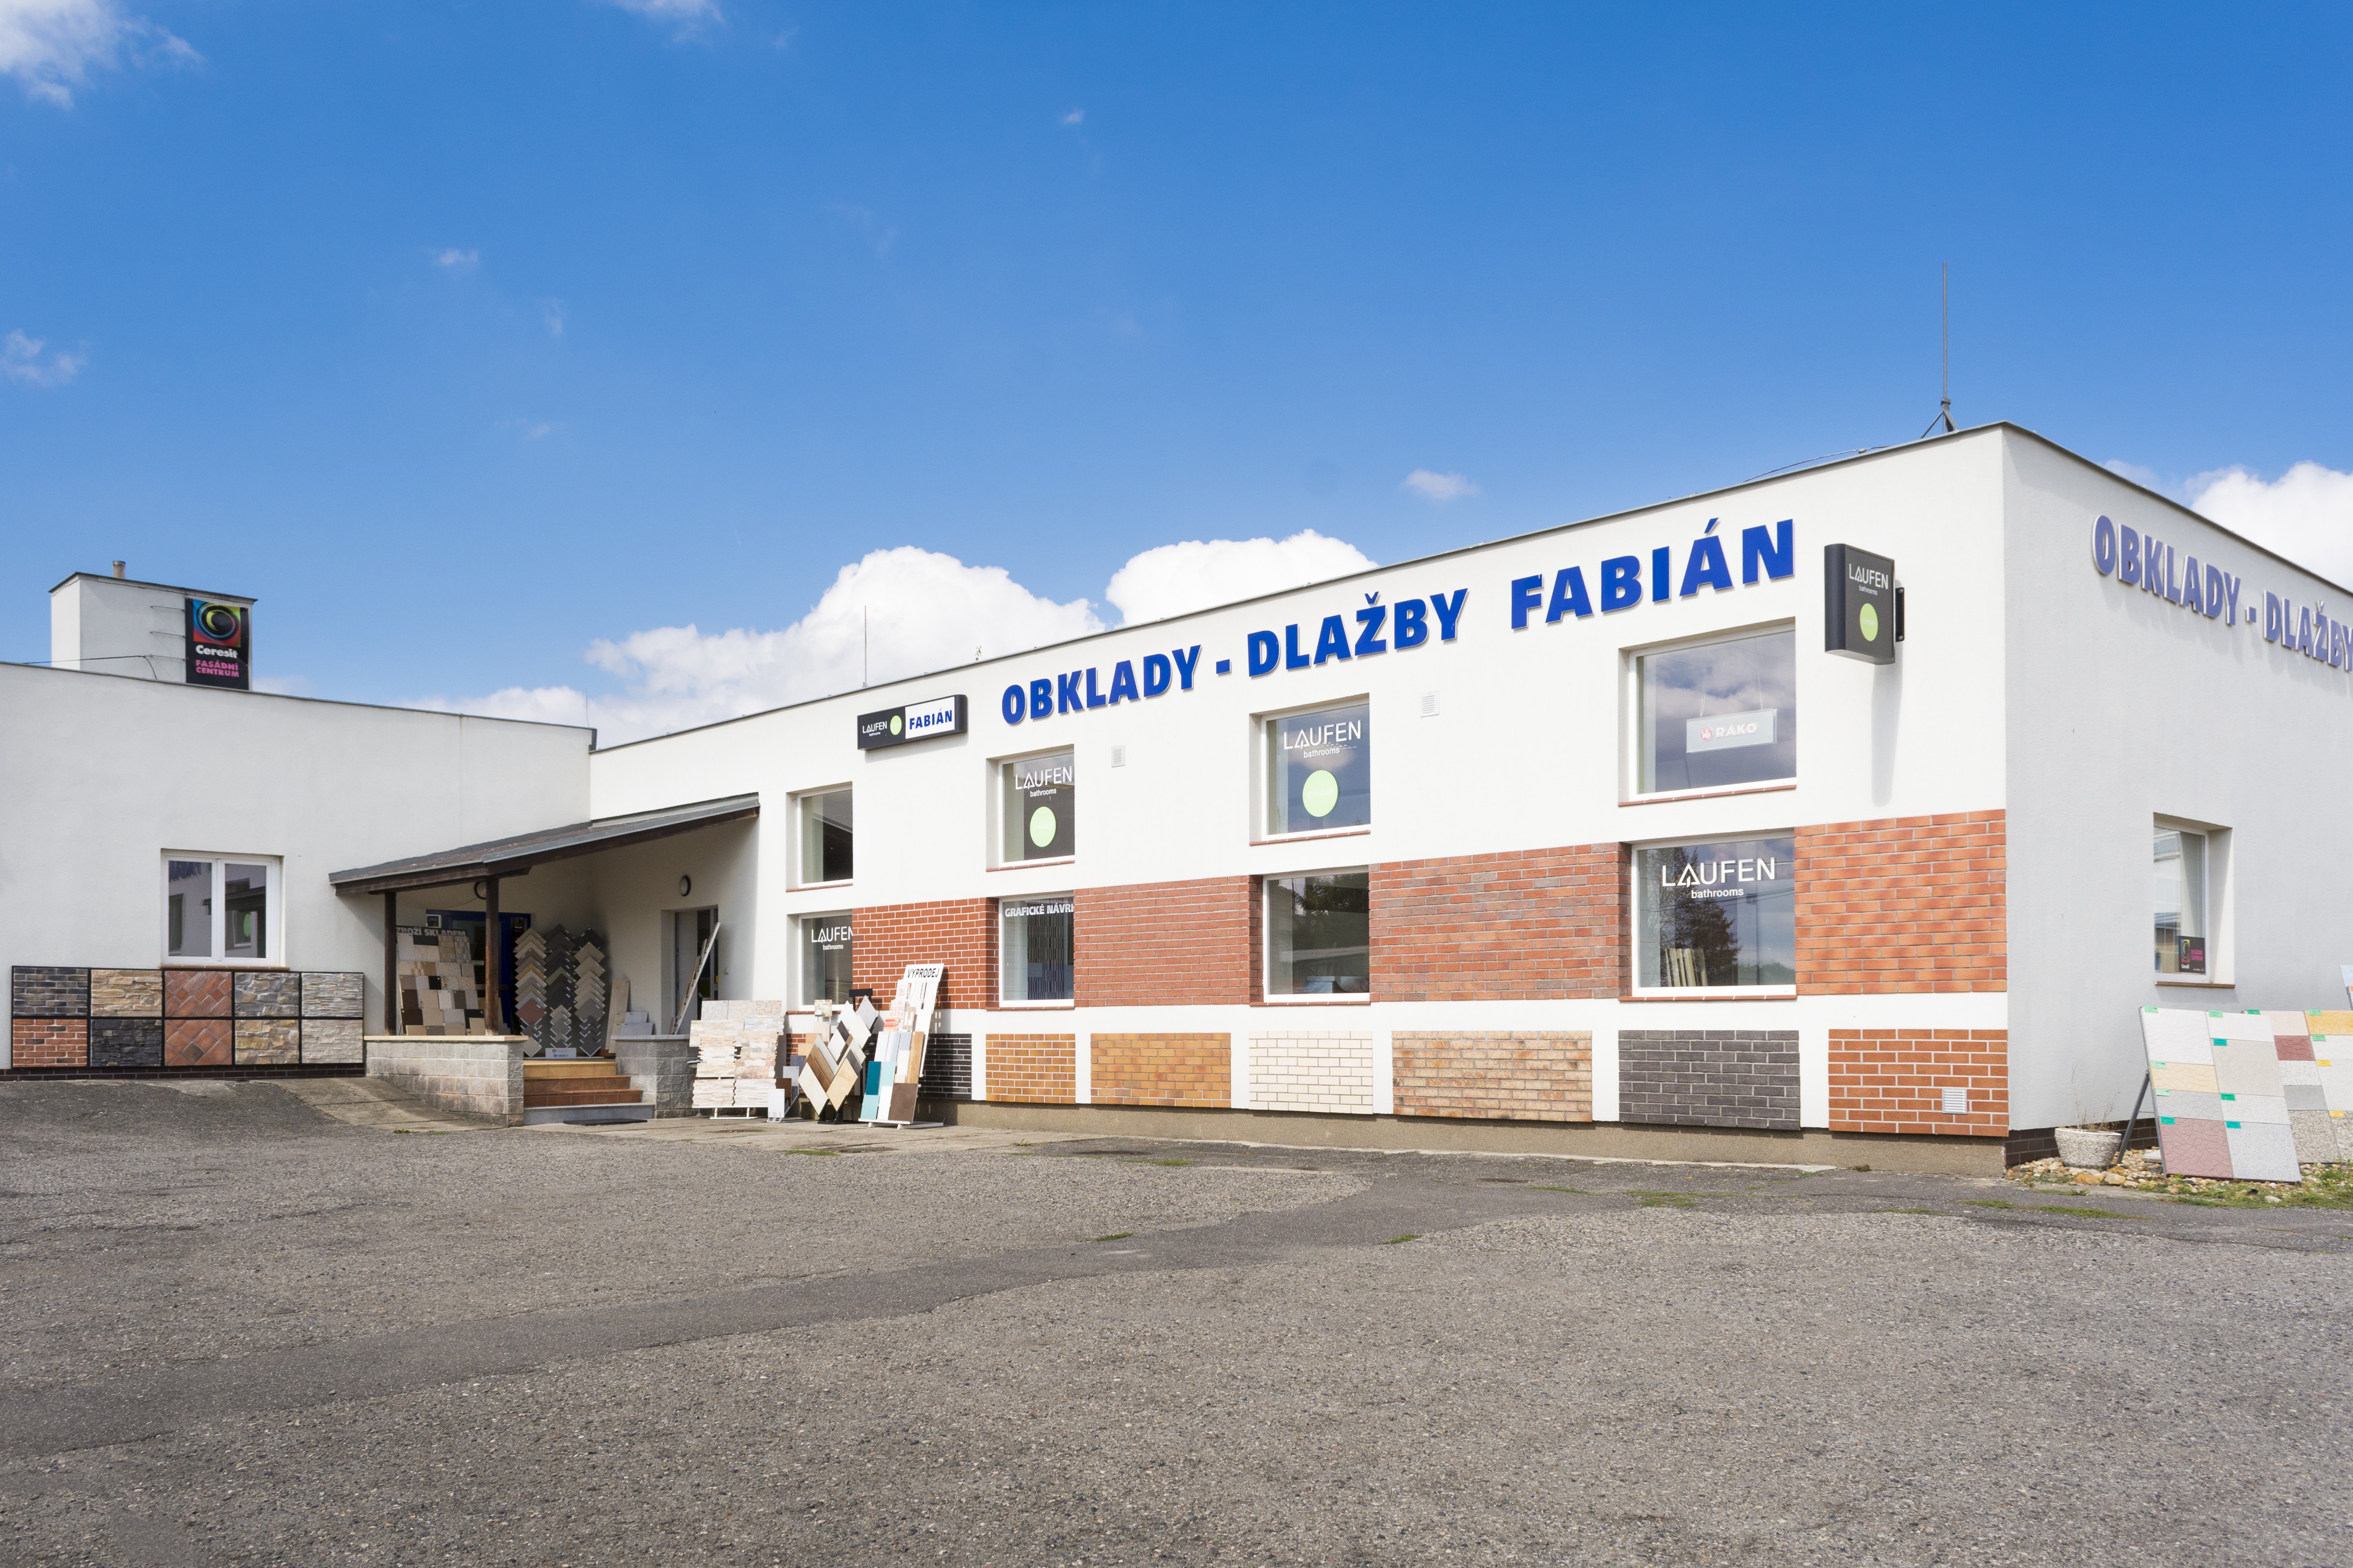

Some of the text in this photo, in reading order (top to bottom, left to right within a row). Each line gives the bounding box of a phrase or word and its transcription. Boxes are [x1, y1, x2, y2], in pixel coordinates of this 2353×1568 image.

[1849, 563, 1889, 589] LAUFEN
[2092, 515, 2241, 626] OBKLADY
[2264, 590, 2353, 672] DLAŽBY
[1001, 518, 1795, 725] OBKLADY - DLAŽBY FABIÁN
[196, 645, 238, 658] Ceresit
[196, 659, 239, 670] FASÁDNÍ
[196, 667, 239, 677] CENTRUM
[862, 721, 887, 733] LAUFEN
[909, 708, 952, 730] FABIÁN
[1284, 719, 1361, 750] LAUFEN
[1715, 722, 1757, 738] RAKO
[1304, 748, 1339, 758] bathrooms
[1015, 766, 1072, 790] LAUFEN
[1030, 788, 1056, 797] bathrooms
[1662, 857, 1775, 888] LAUFEN
[1691, 888, 1744, 899] bathrooms
[1005, 904, 1045, 917] GRAFICKÉ
[811, 926, 853, 943] LAUFEN
